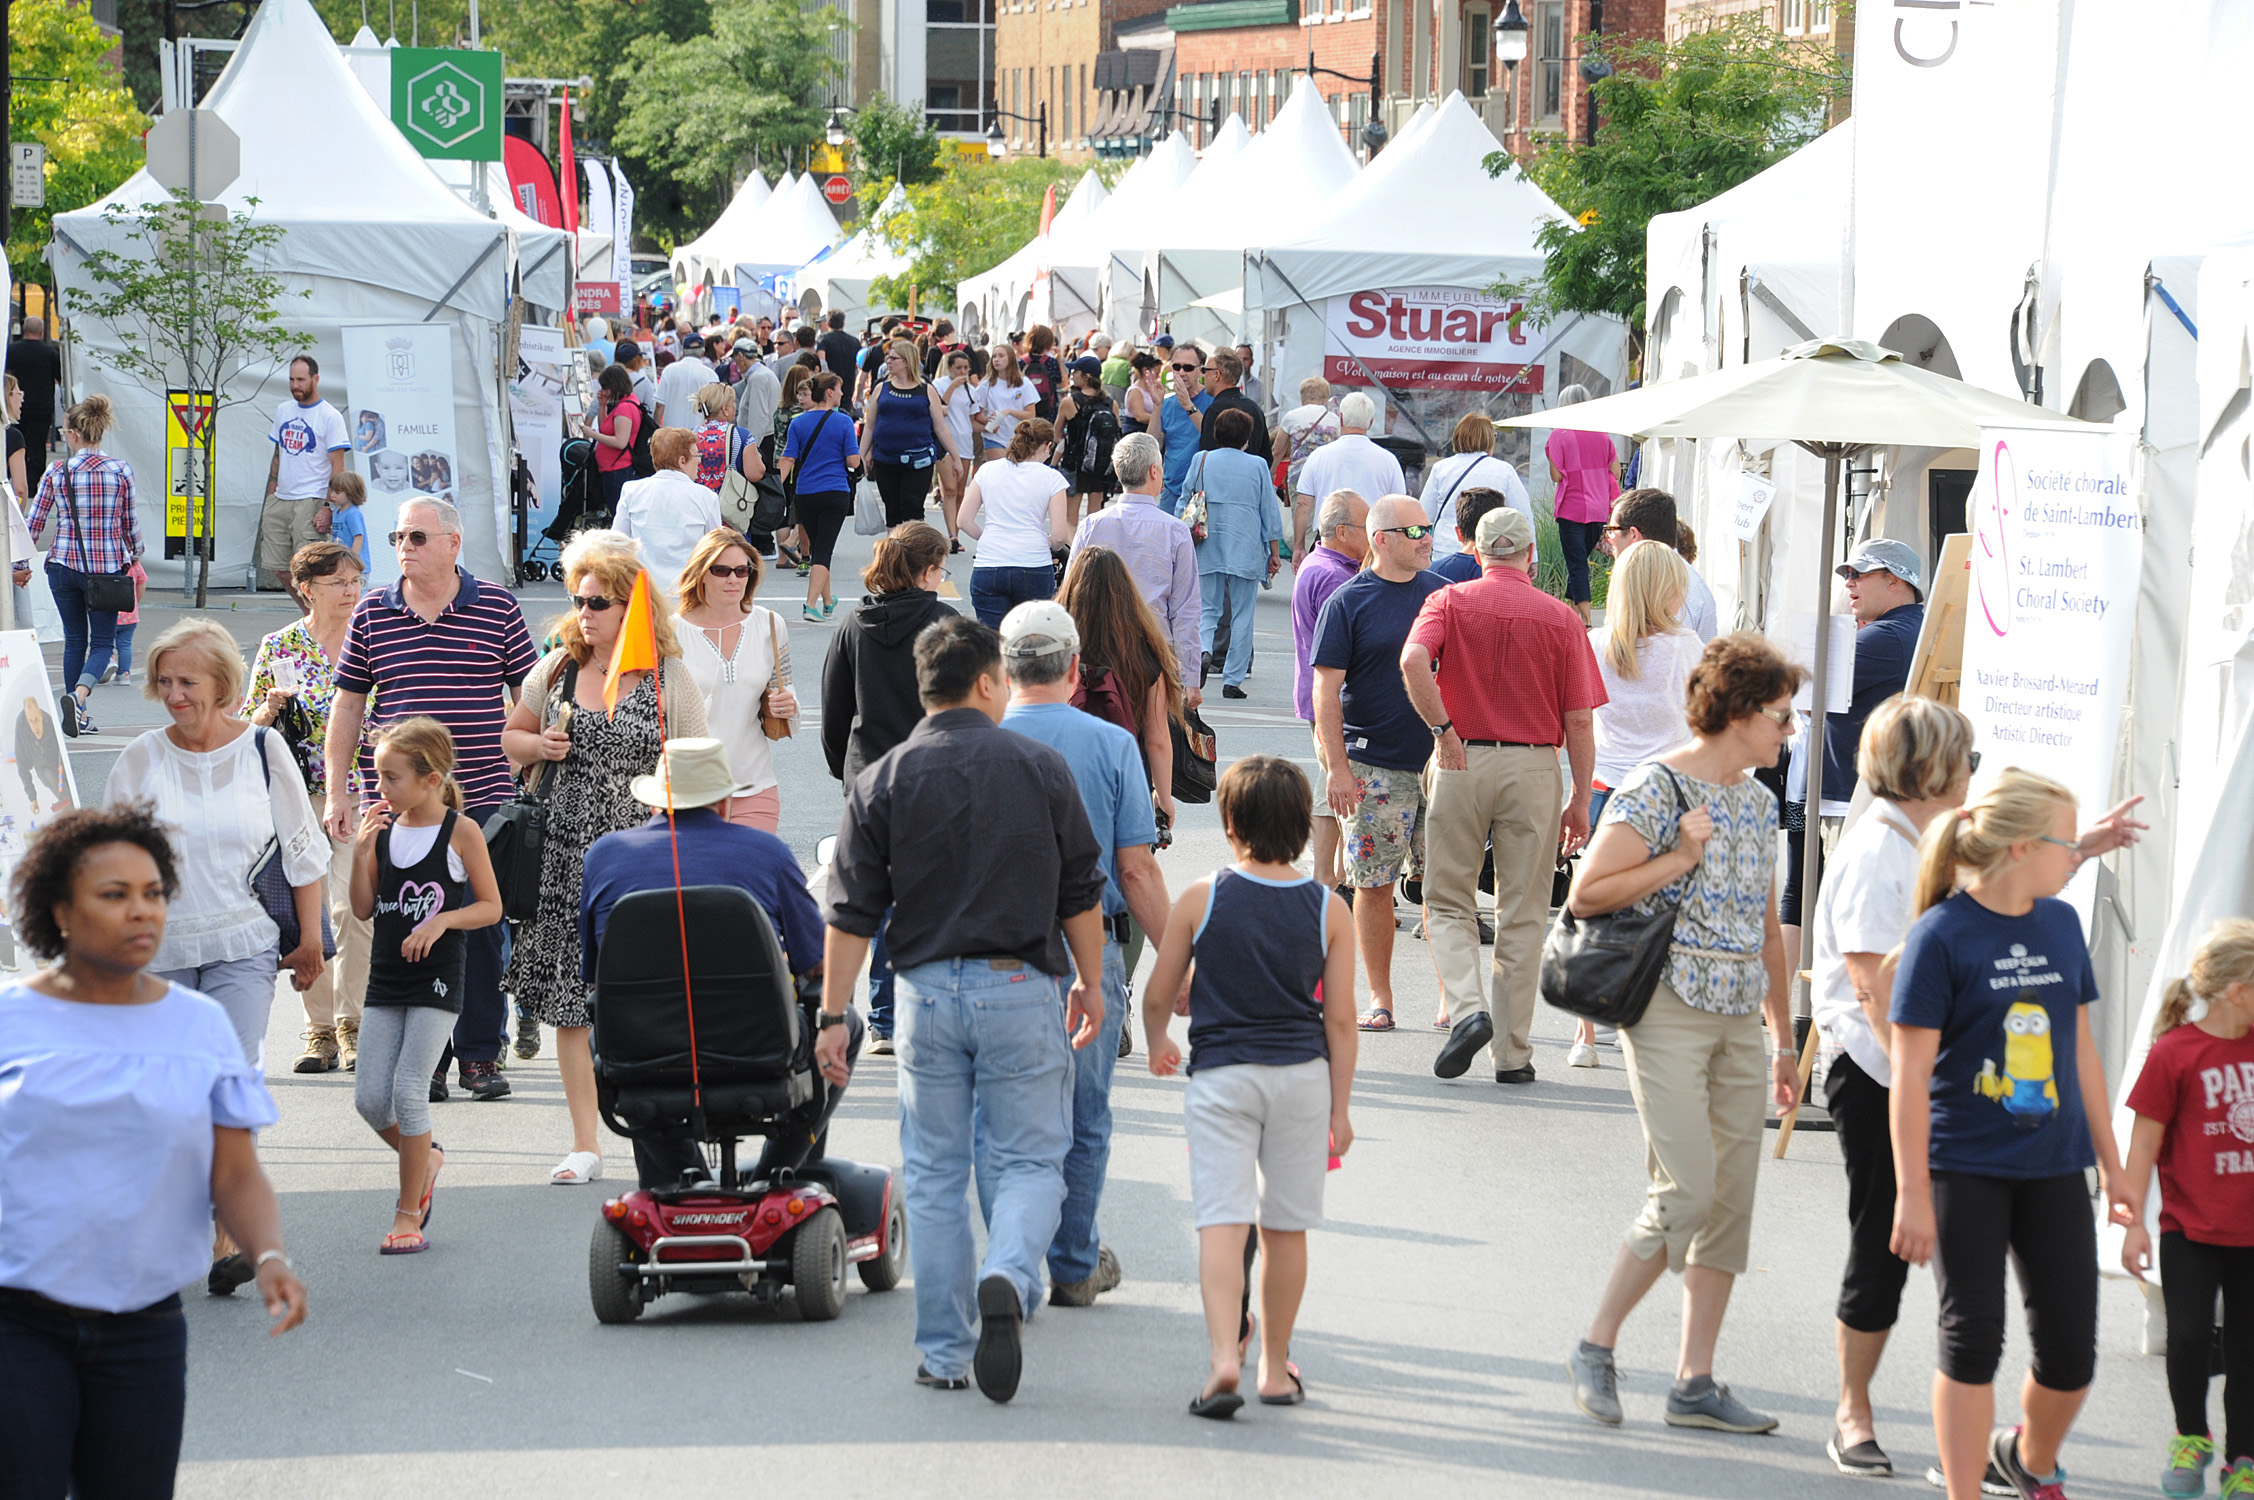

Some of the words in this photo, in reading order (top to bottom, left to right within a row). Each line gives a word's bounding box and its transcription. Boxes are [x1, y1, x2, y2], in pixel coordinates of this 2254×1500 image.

[23, 148, 33, 160] P
[826, 185, 850, 195] ARRÊT
[1413, 290, 1501, 304] IMMEUBLES
[1346, 290, 1527, 346] Stuart
[1388, 345, 1422, 355] AGENCE
[1423, 346, 1478, 356] IMMOBILIÈRE
[1374, 367, 1410, 380] maison
[1412, 369, 1426, 380] est
[1428, 373, 1441, 381] au
[1443, 373, 1469, 383] cœur
[1471, 367, 1482, 382] de
[1485, 373, 1511, 384] notre
[398, 424, 438, 435] FAMILLE
[284, 437, 303, 450] TEAM
[2027, 469, 2071, 492] Société
[2075, 471, 2128, 496] chorale
[2024, 501, 2039, 522] de
[2042, 503, 2139, 529] Saint-Lambert
[2019, 556, 2034, 576] St.
[2039, 557, 2088, 579] Lambert
[2016, 587, 2057, 609] Choral
[2061, 591, 2110, 621] Society
[1976, 668, 2009, 687] Xavier
[1985, 696, 2032, 716] Directeur
[2035, 701, 2082, 725] artistique
[1991, 724, 2027, 743] Artistic
[2029, 727, 2073, 747] Director
[402, 890, 437, 921] with
[1993, 957, 2020, 971] KEEP
[2020, 955, 2048, 968] CALM
[1989, 976, 2010, 990] EAT
[2009, 976, 2019, 987] A
[2017, 972, 2064, 987] BANANA
[672, 1212, 745, 1225] SHOPRIDER
